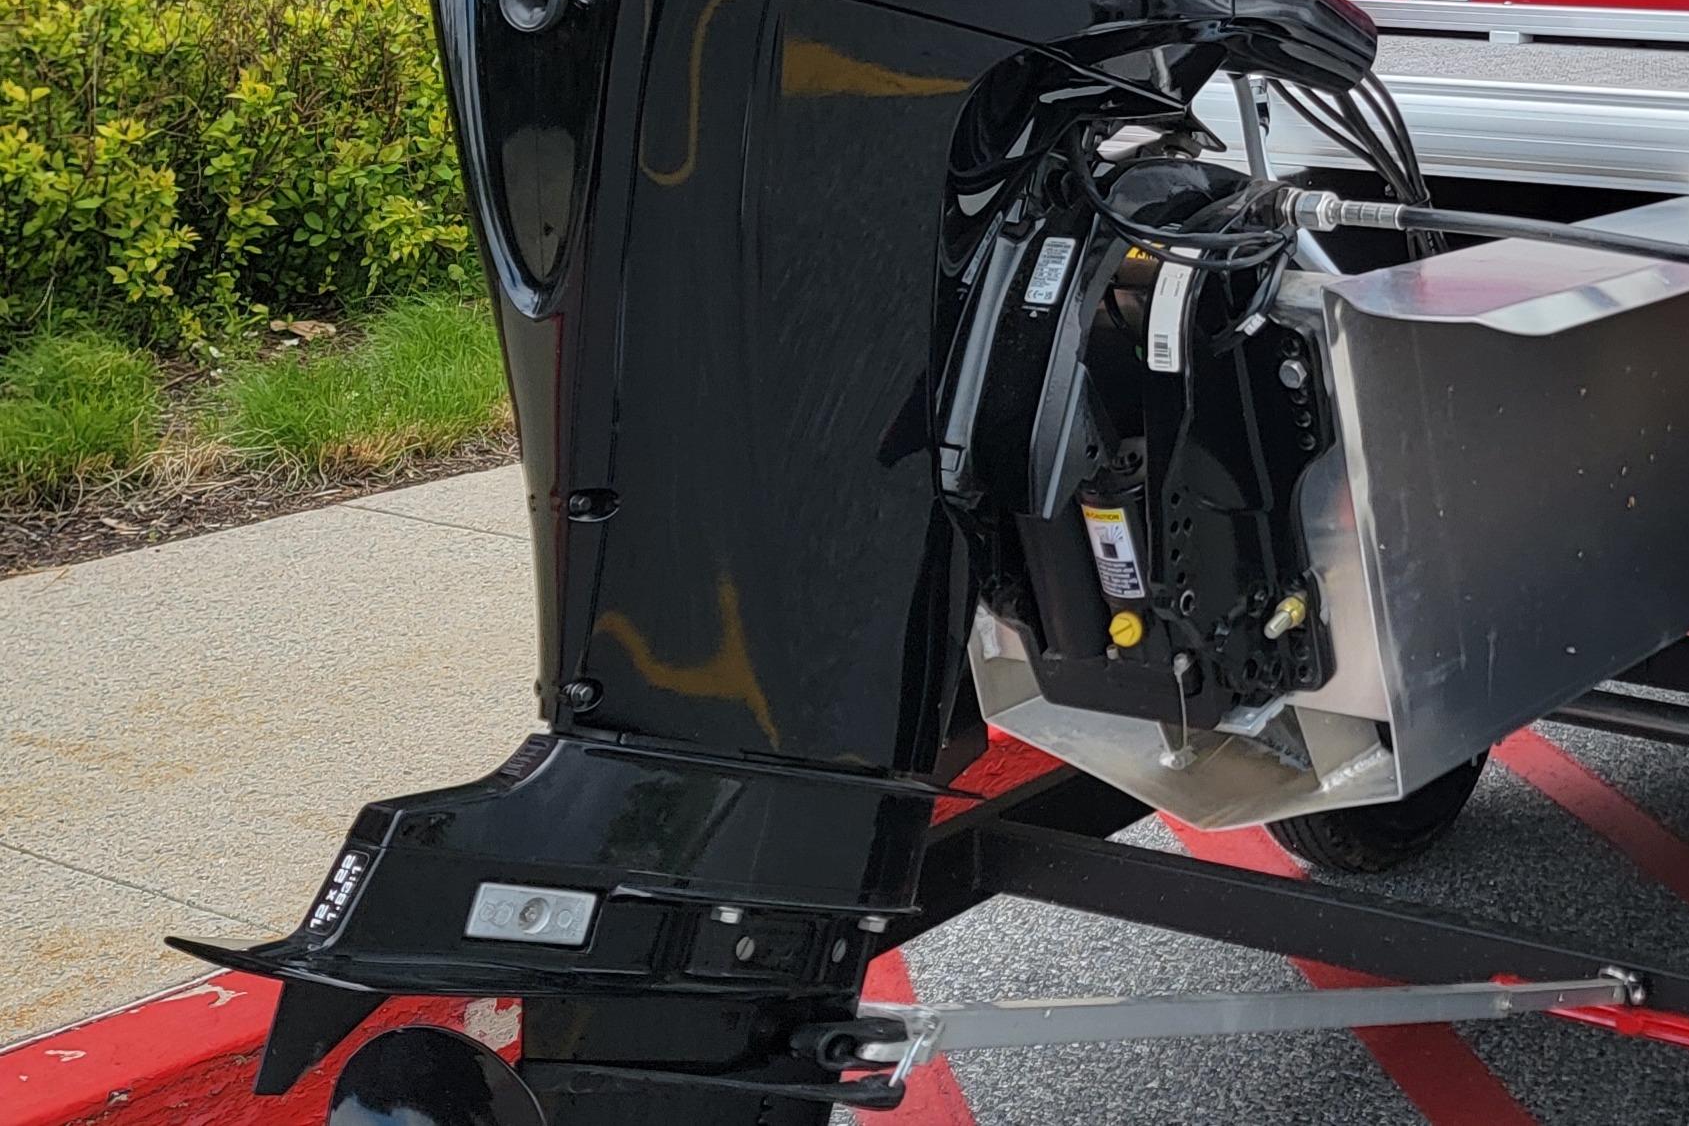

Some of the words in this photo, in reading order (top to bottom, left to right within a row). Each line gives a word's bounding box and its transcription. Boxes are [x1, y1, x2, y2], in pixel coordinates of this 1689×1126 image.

[310, 903, 330, 928] 12
[333, 854, 356, 884] 22
[326, 866, 361, 922] 1.83:1
